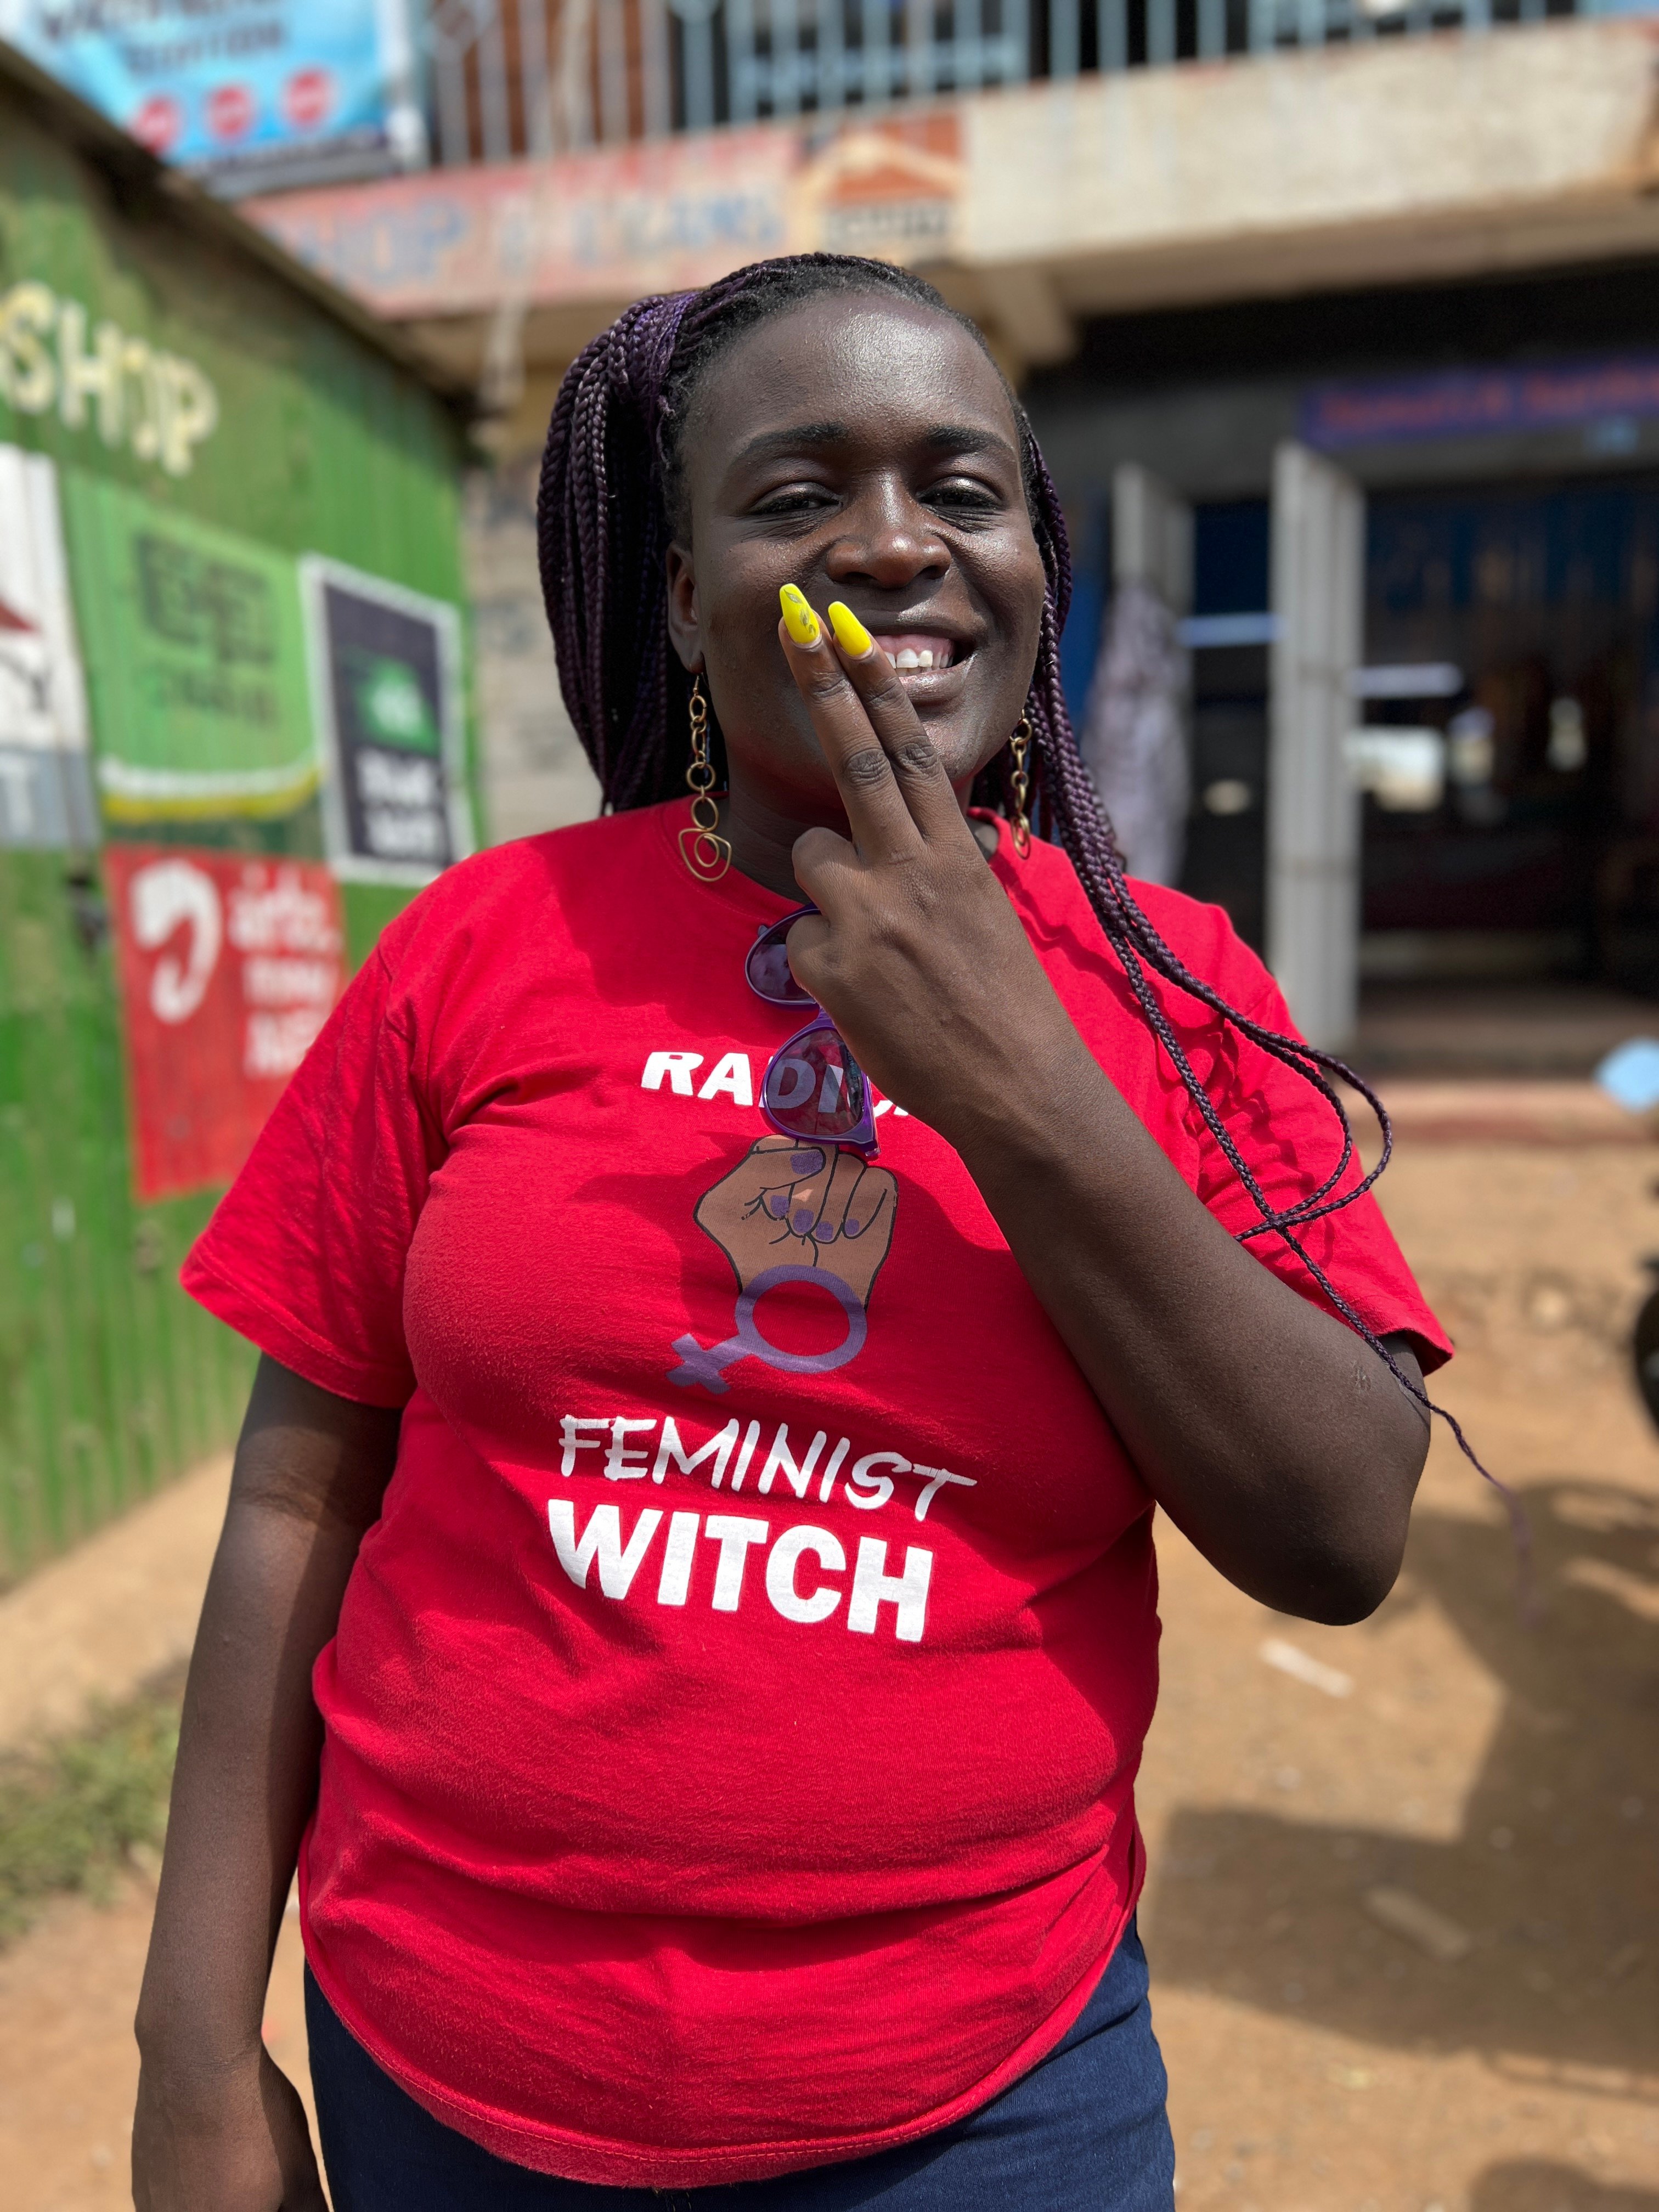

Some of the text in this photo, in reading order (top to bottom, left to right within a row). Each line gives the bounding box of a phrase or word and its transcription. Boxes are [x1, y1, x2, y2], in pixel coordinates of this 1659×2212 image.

[641, 1051, 909, 1116] RADI
[558, 1414, 978, 1522] FEMINIST
[548, 1498, 933, 1643] WITCH
